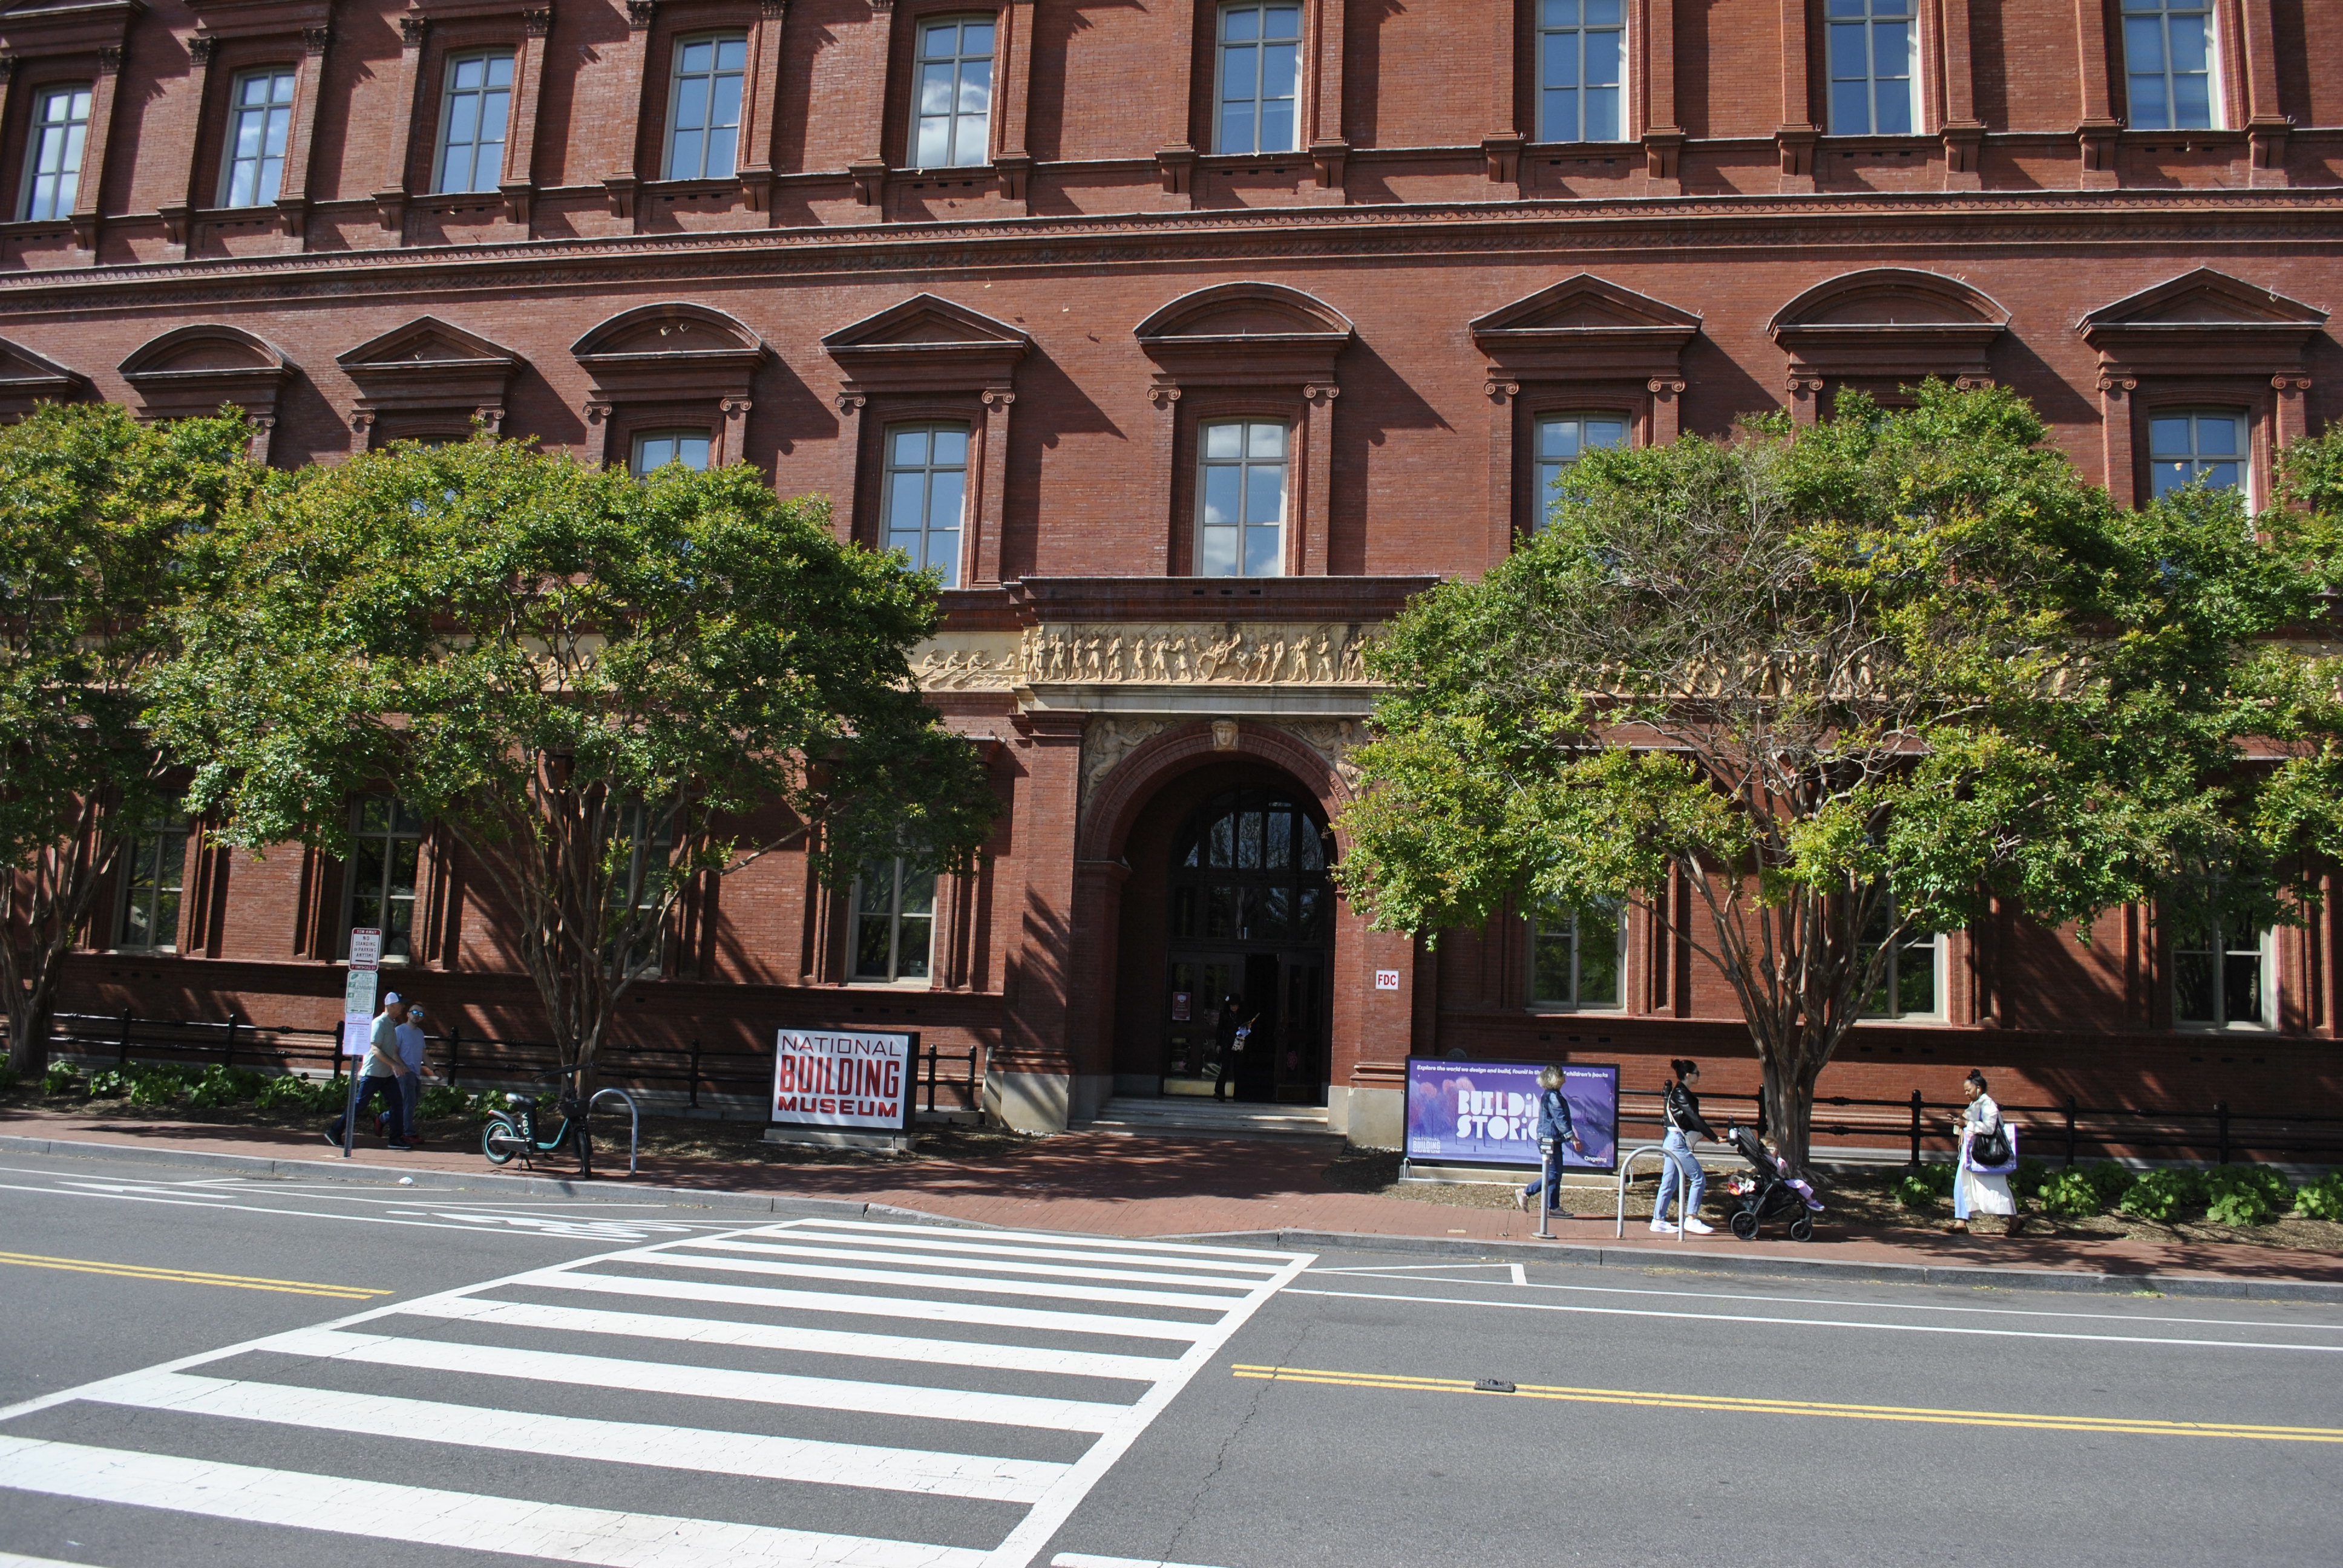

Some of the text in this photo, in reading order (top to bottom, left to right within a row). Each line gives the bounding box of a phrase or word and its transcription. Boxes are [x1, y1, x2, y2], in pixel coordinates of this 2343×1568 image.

[1378, 974, 1396, 985] FDC
[782, 1036, 901, 1057] NATIONAL
[779, 1054, 900, 1098] BUILDING
[778, 1096, 897, 1118] MUSEUM
[1413, 1140, 1441, 1149] BUILDING
